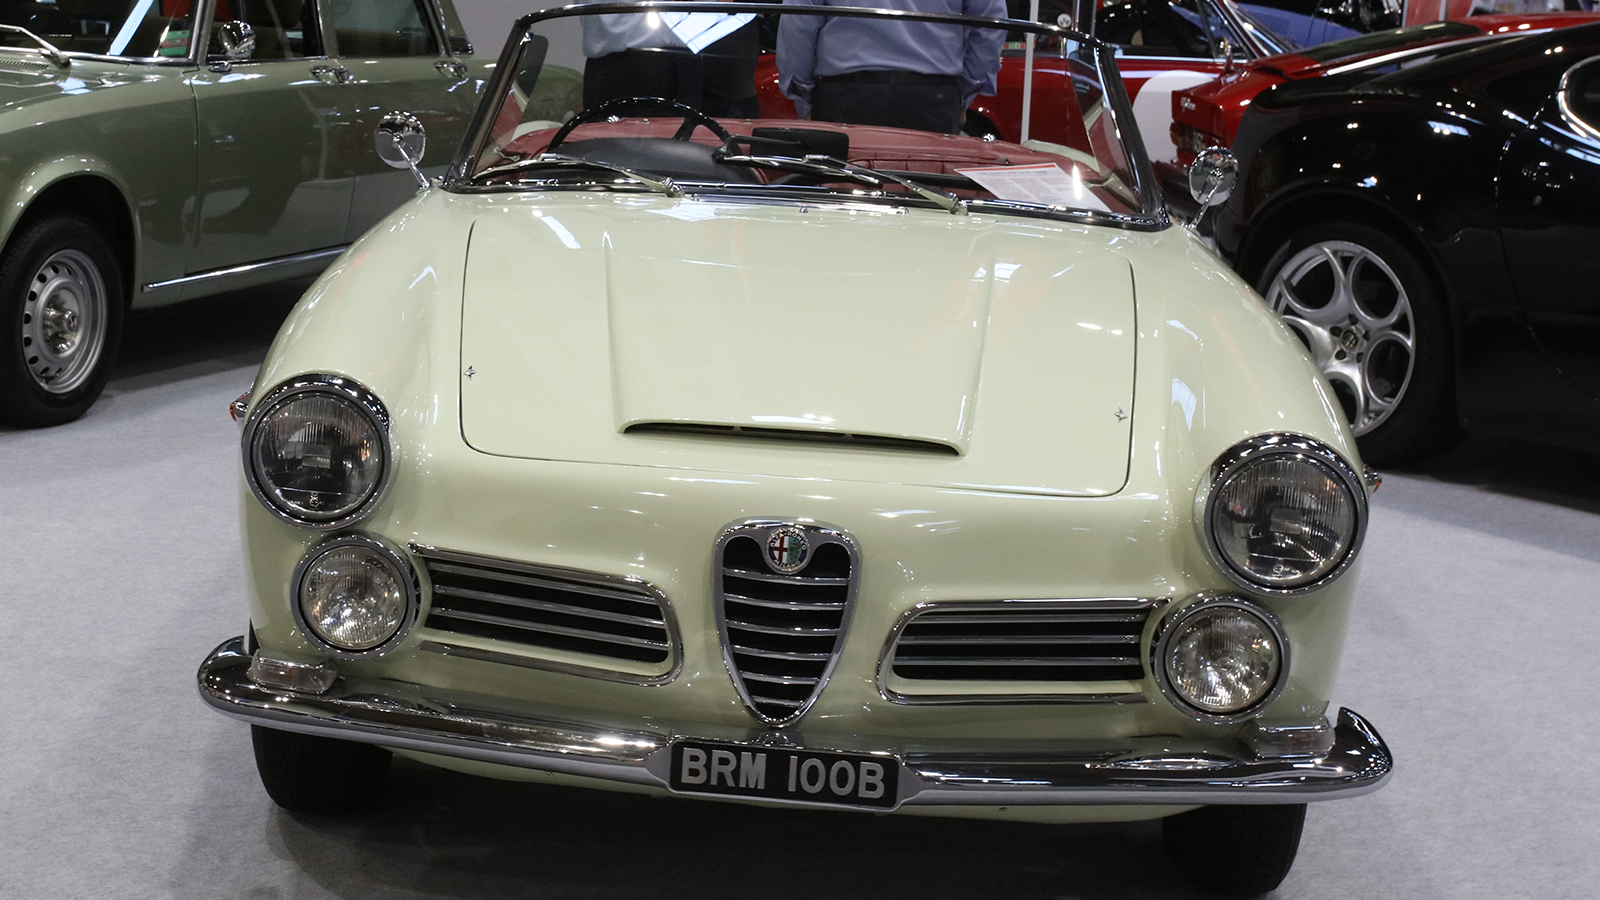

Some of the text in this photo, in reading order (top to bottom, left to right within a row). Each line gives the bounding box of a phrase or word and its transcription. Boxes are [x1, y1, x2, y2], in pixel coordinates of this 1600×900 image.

[773, 559, 801, 568] MILANO
[681, 747, 885, 799] BRM 100B
